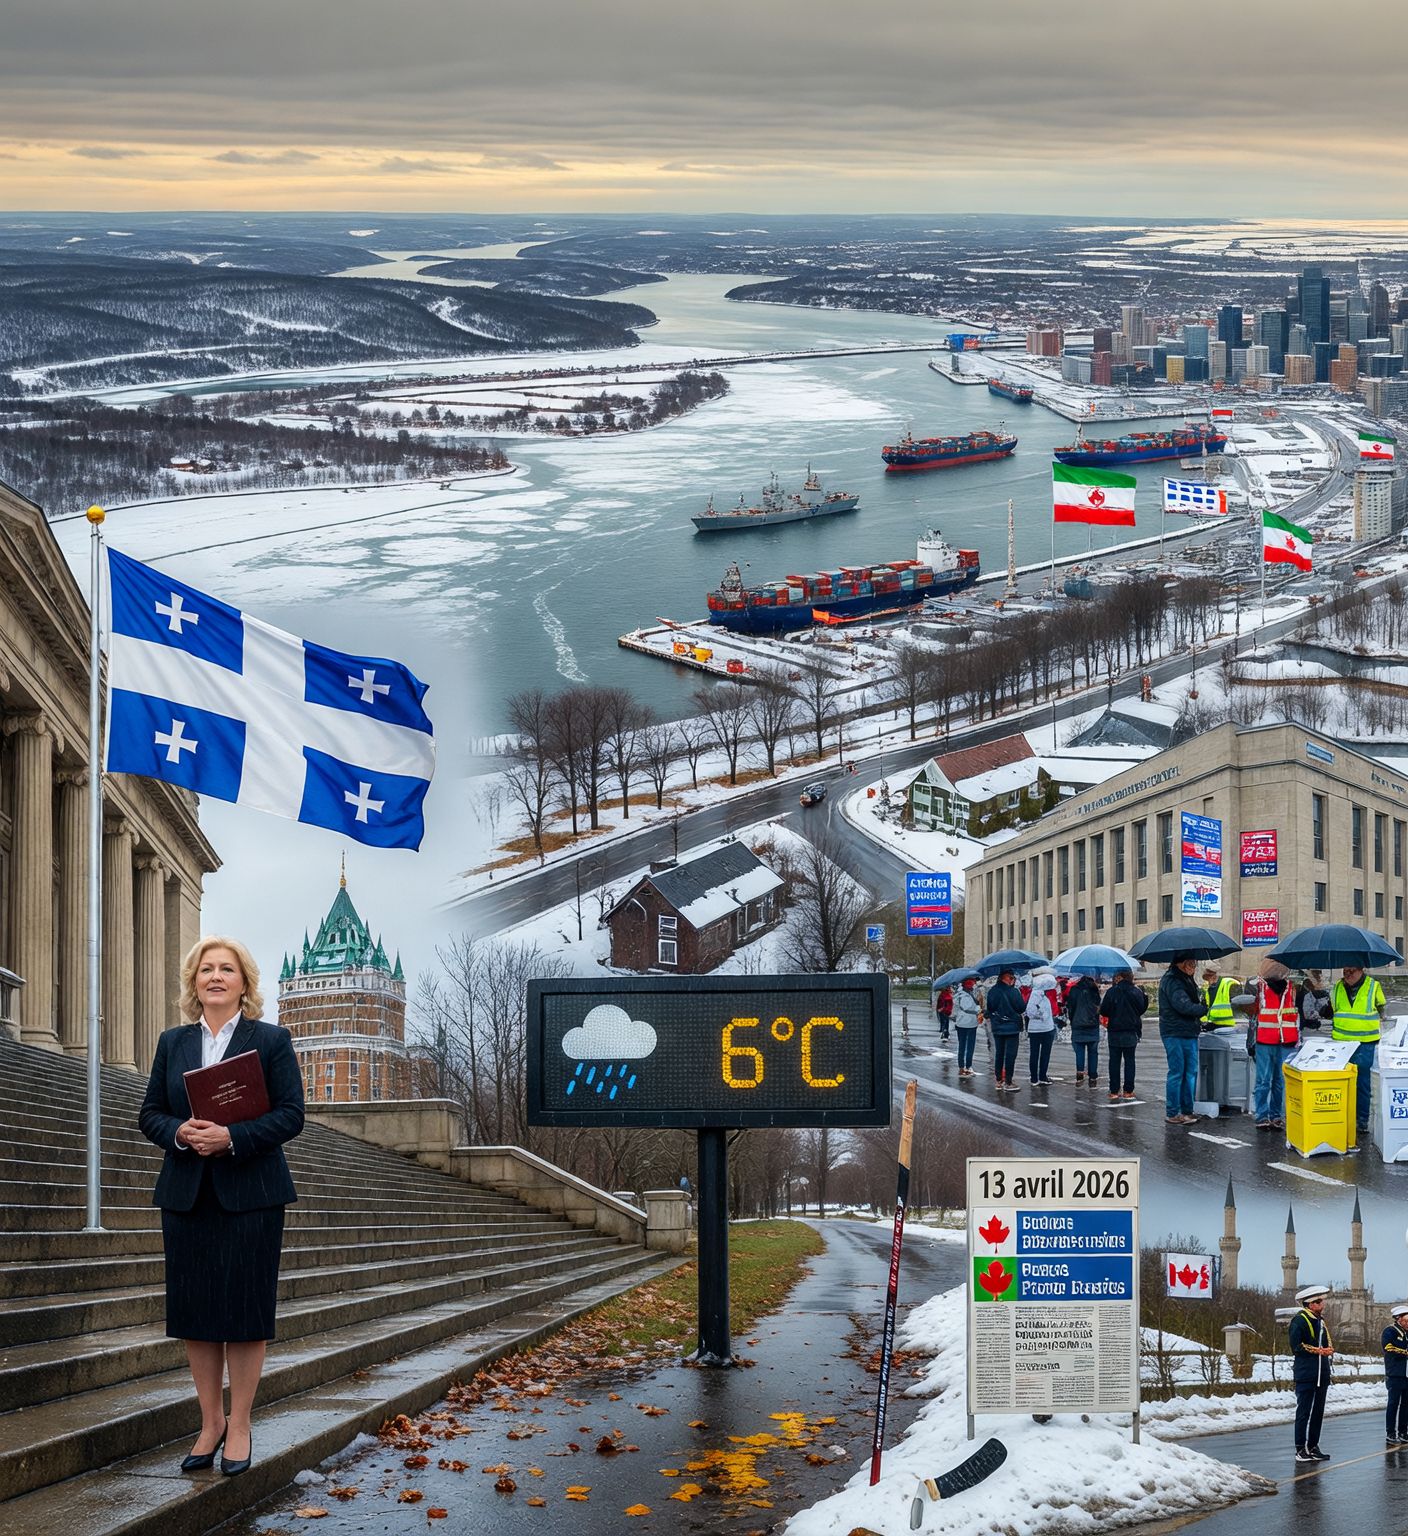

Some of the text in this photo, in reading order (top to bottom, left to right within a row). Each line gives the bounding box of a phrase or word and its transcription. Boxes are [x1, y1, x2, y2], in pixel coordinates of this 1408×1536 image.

[721, 1016, 846, 1089] 6°C
[979, 1168, 1130, 1199] 13 avril 2026
